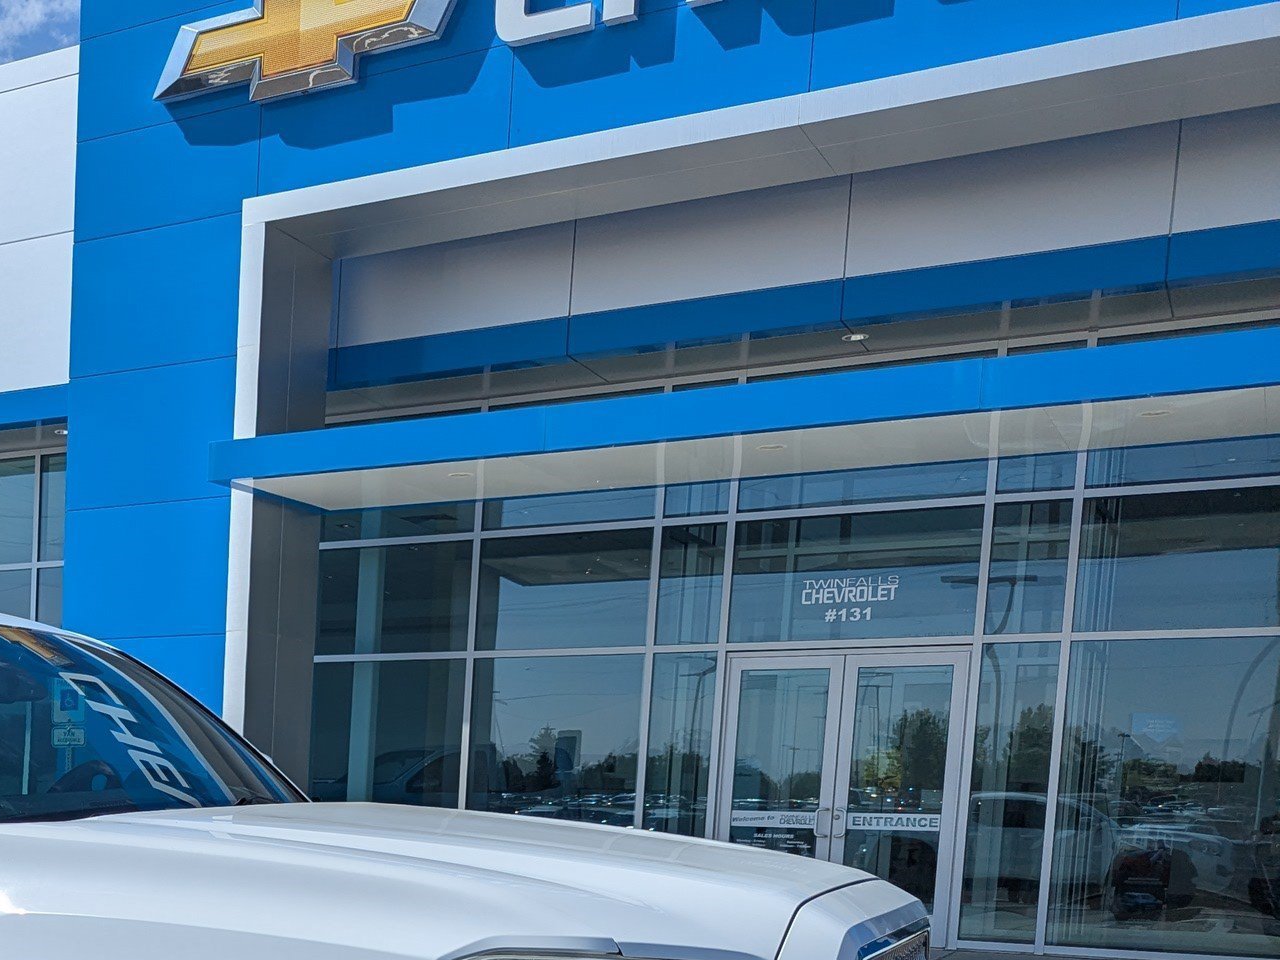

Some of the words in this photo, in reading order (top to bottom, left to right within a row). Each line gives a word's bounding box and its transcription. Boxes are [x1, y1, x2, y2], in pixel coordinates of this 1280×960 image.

[801, 585, 898, 605] CHEVROLET
[824, 606, 872, 622] #131
[852, 816, 939, 828] ENTRANCE
